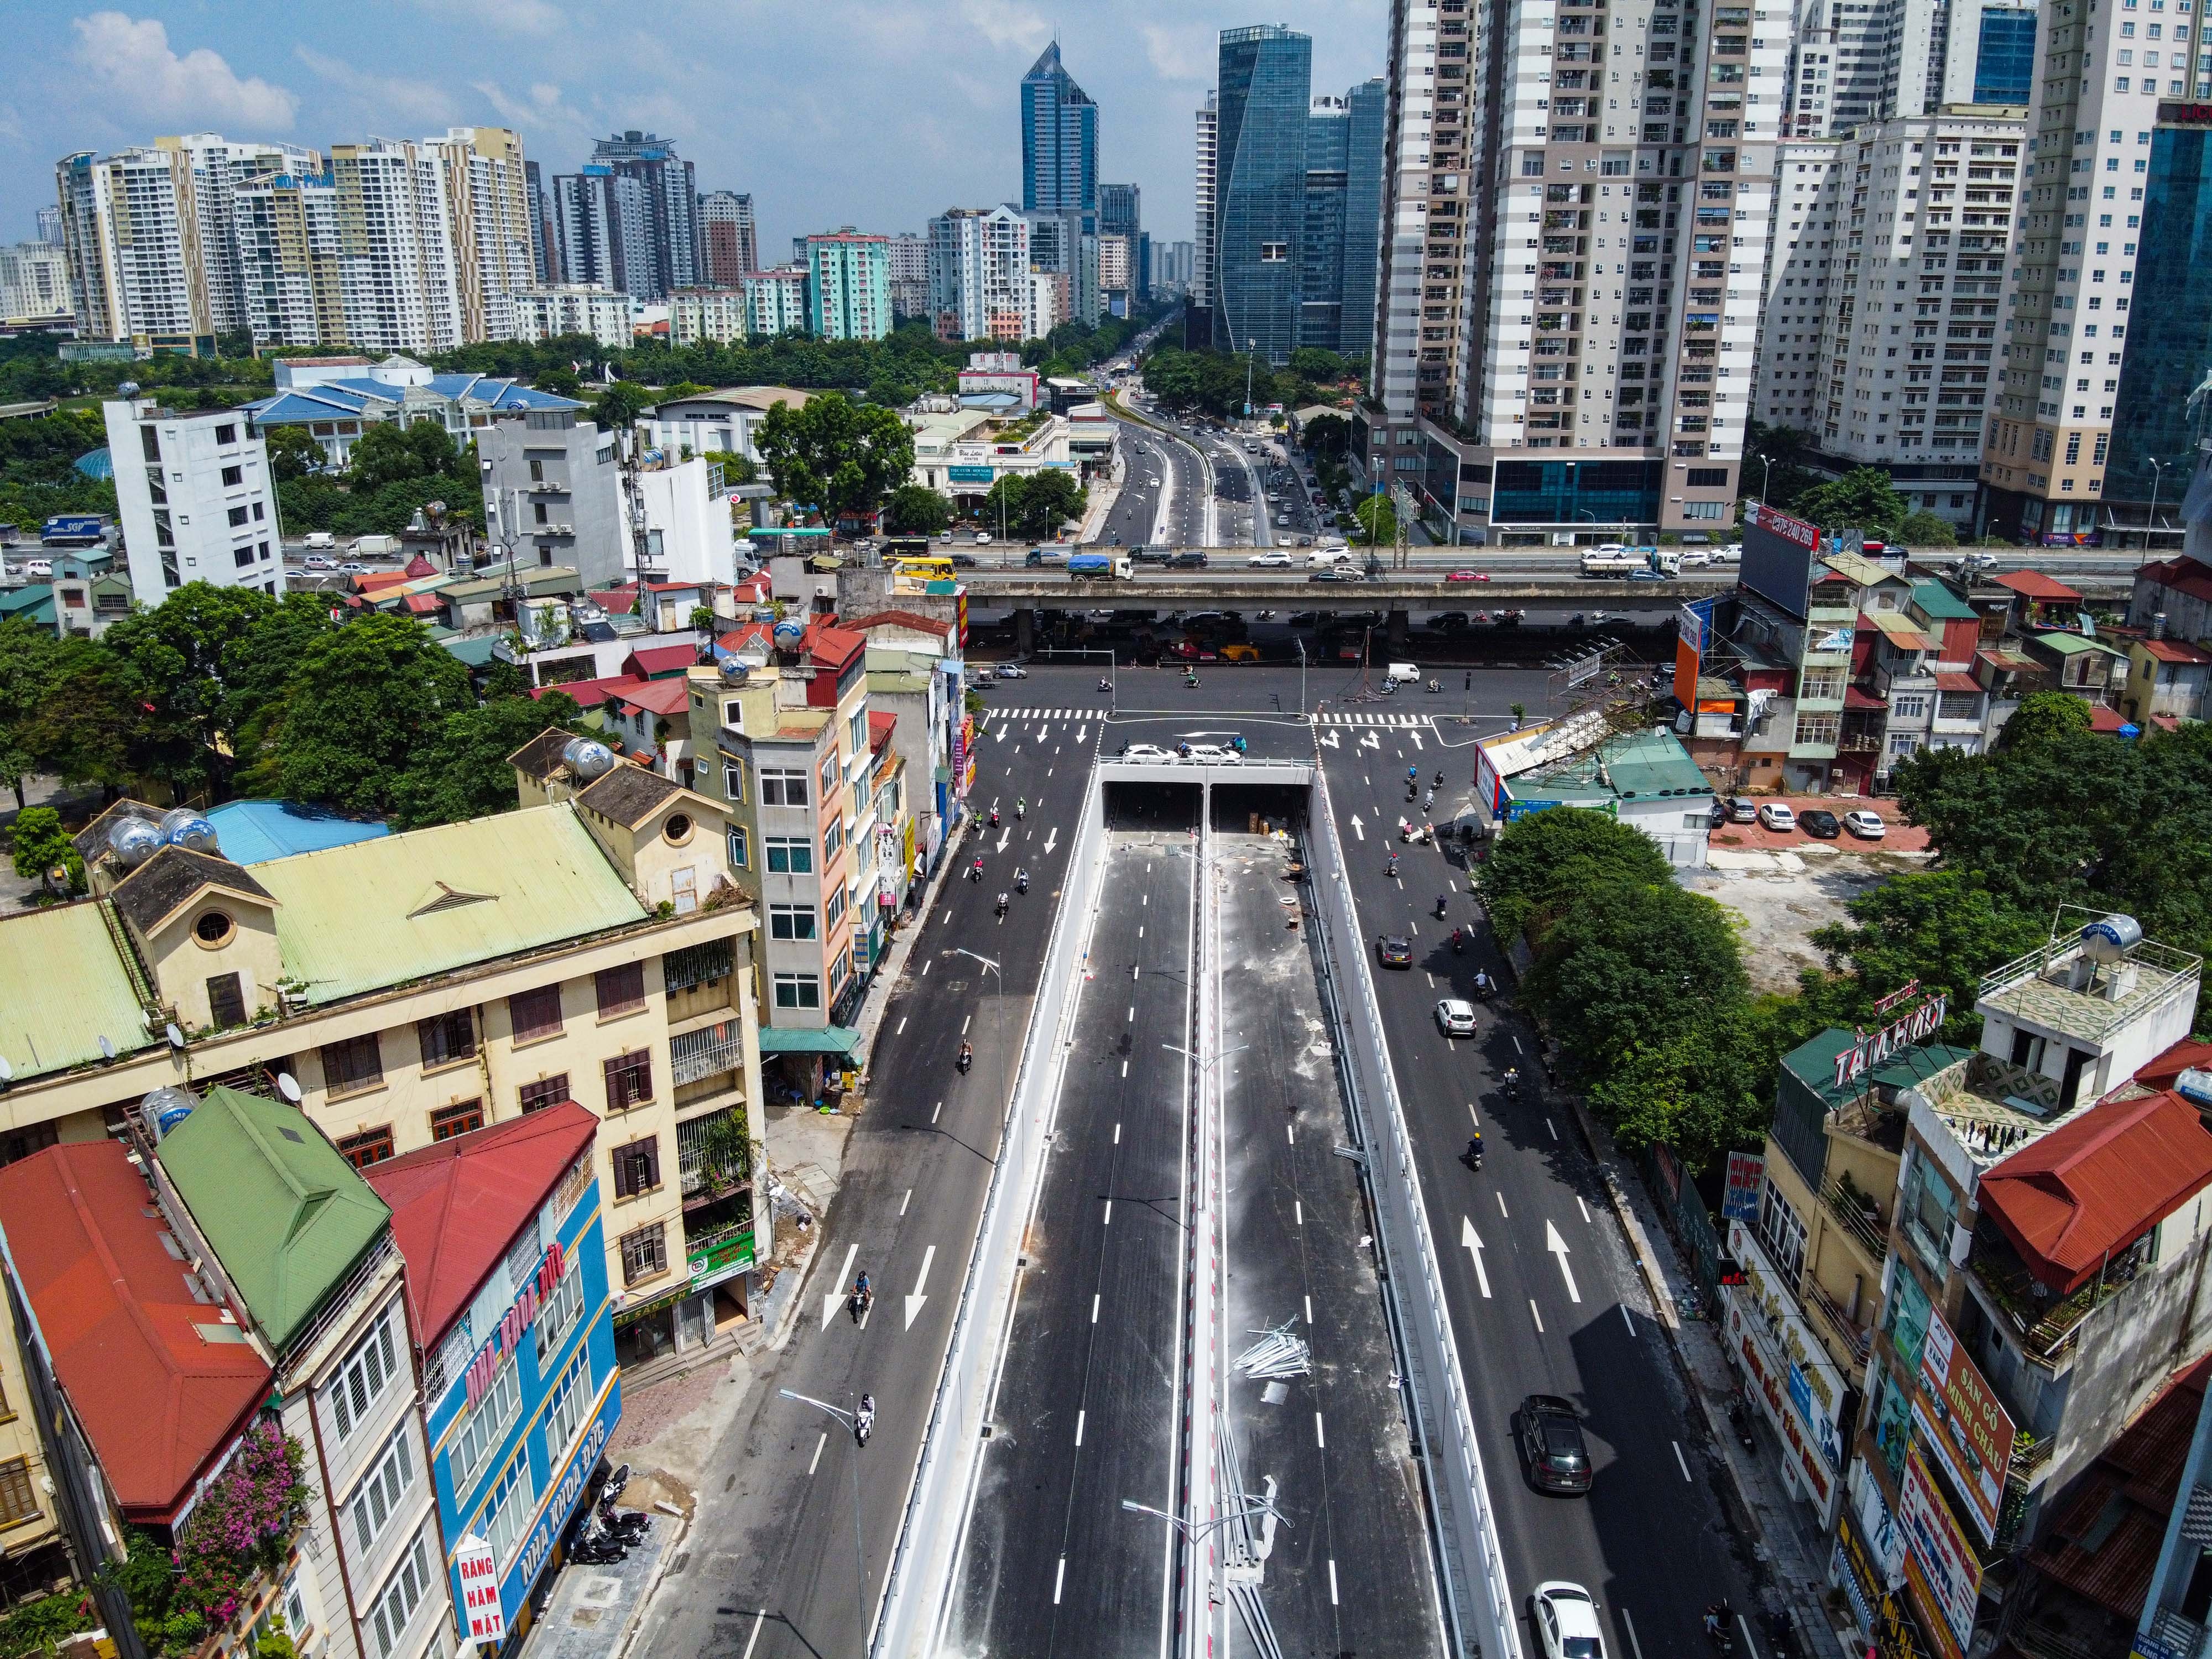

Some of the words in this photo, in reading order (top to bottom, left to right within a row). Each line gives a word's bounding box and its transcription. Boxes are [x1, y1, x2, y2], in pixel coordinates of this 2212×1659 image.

[1787, 521, 1800, 540] 240
[1799, 529, 1813, 546] 269
[613, 1315, 629, 1328] ẢI
[466, 1338, 498, 1411] NHA
[500, 1282, 538, 1359] KHOA
[1981, 1390, 2000, 1436] GỖ
[1946, 1376, 1973, 1429] MINH
[1973, 1413, 2004, 1477] CHÂU
[521, 1523, 549, 1587] NHA
[550, 1463, 581, 1533] KHOA
[582, 1418, 604, 1474] ĐỨC
[461, 1557, 494, 1580] RĂNG
[467, 1585, 497, 1609] HÀM
[472, 1613, 500, 1637] MẶT
[2138, 1634, 2159, 1650] QUANG
